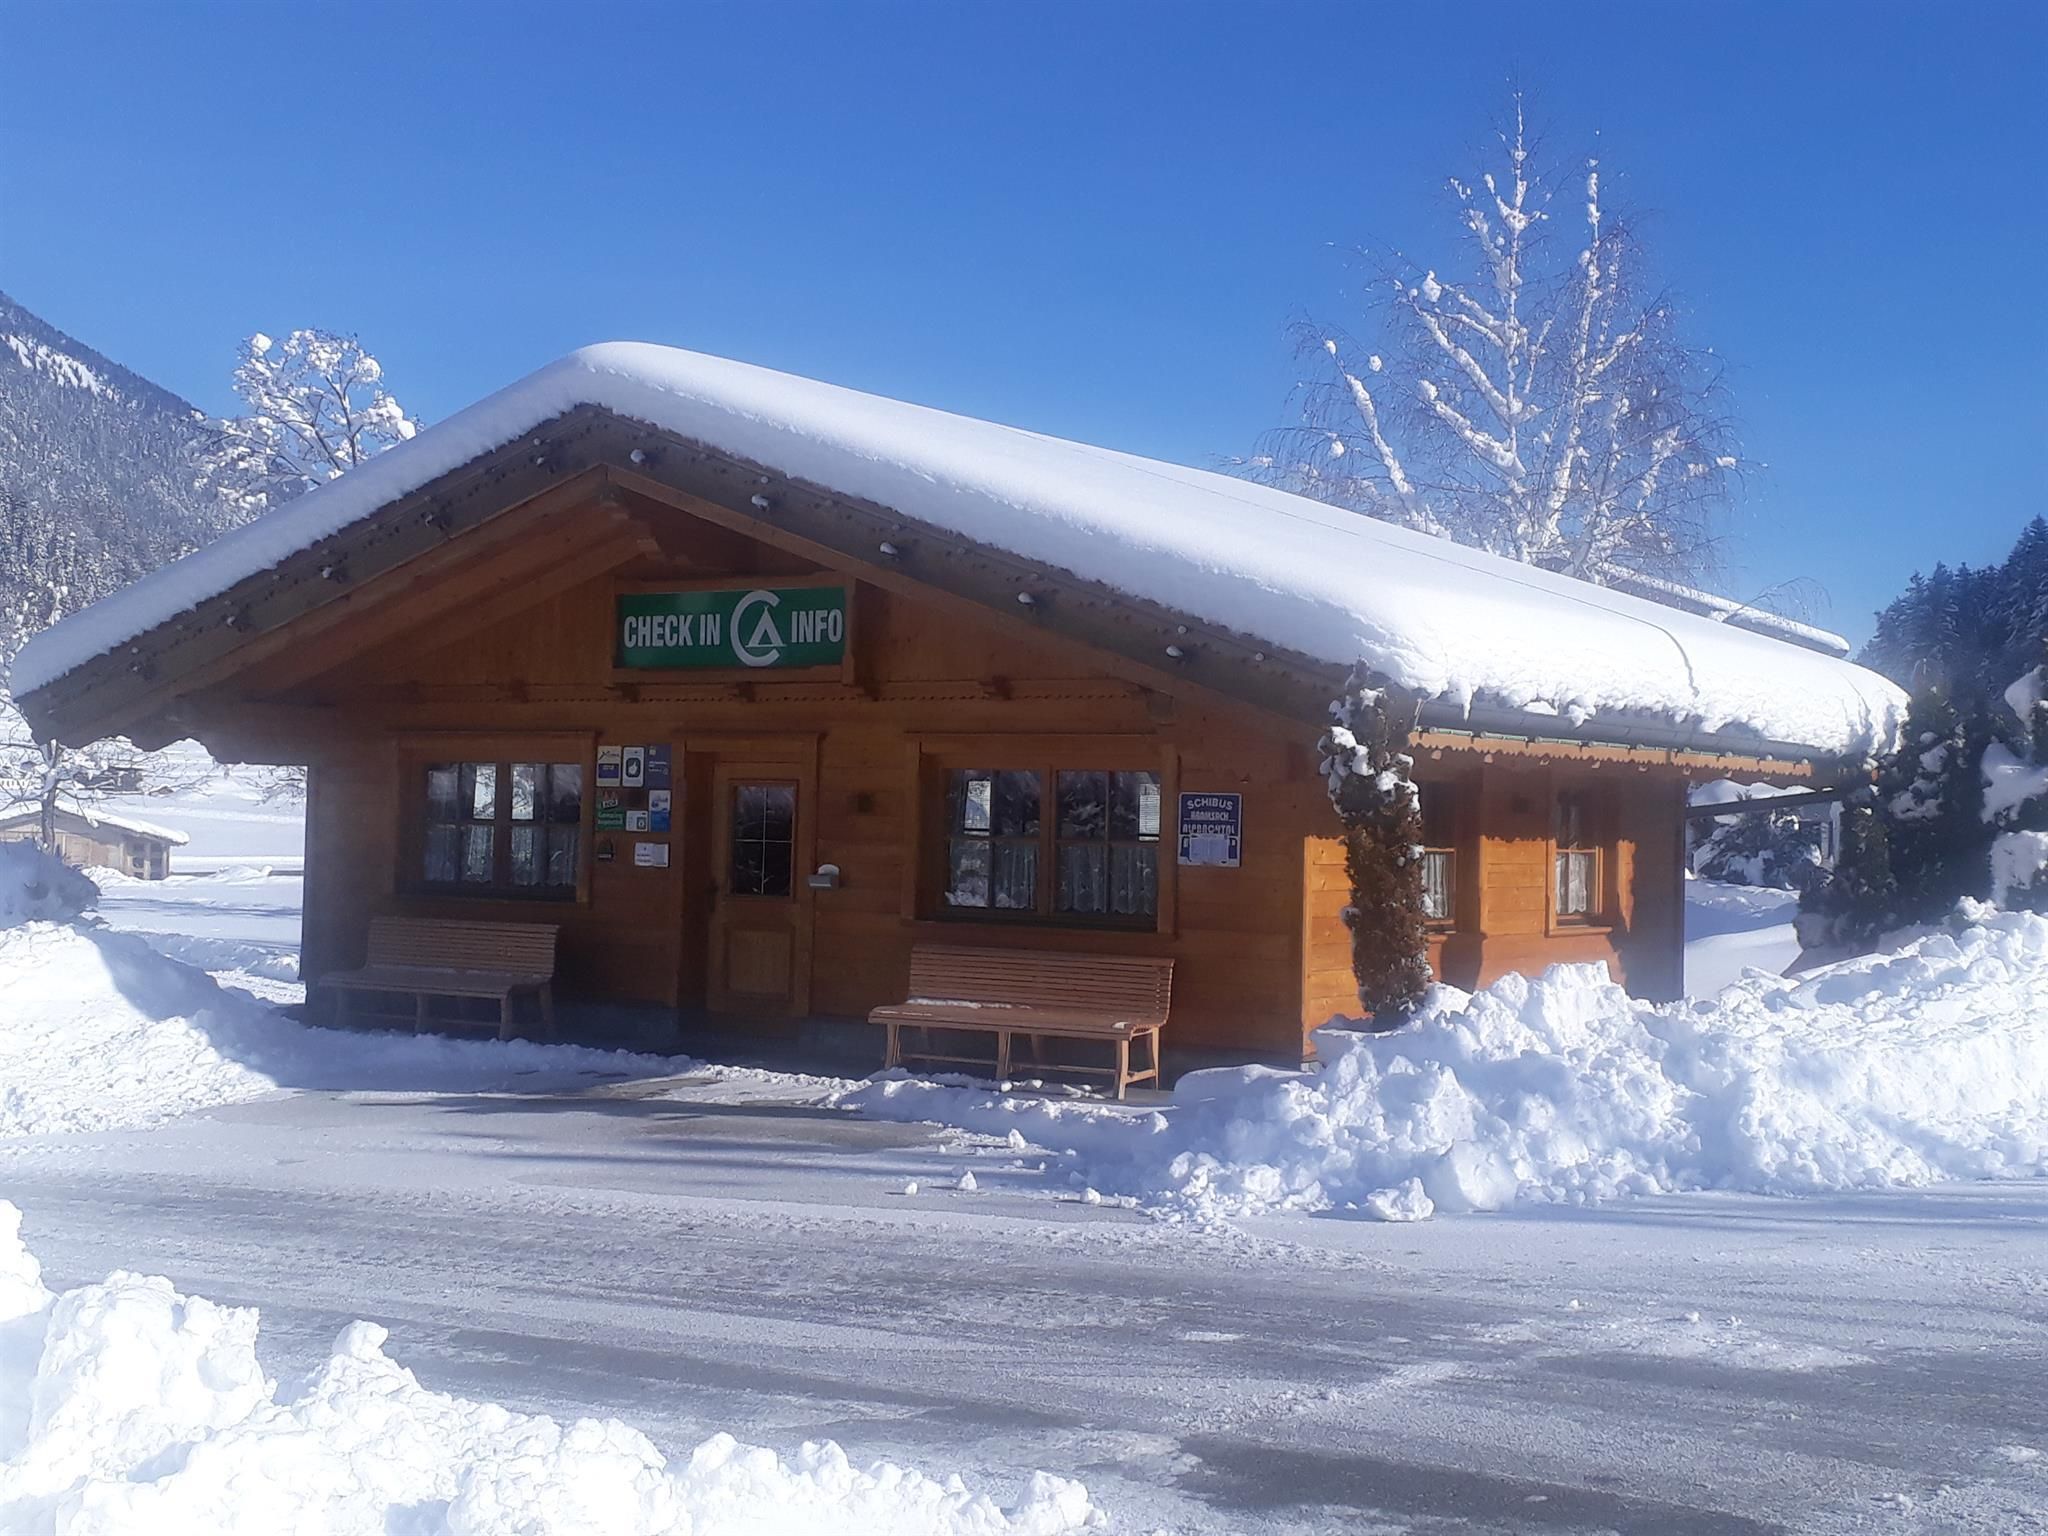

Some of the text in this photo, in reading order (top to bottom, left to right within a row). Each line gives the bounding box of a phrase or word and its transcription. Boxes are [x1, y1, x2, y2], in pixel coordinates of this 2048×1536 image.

[624, 614, 693, 648] CHECK
[699, 613, 721, 646] IN
[791, 608, 842, 643] INFO
[1187, 798, 1233, 811] SCHIBUS
